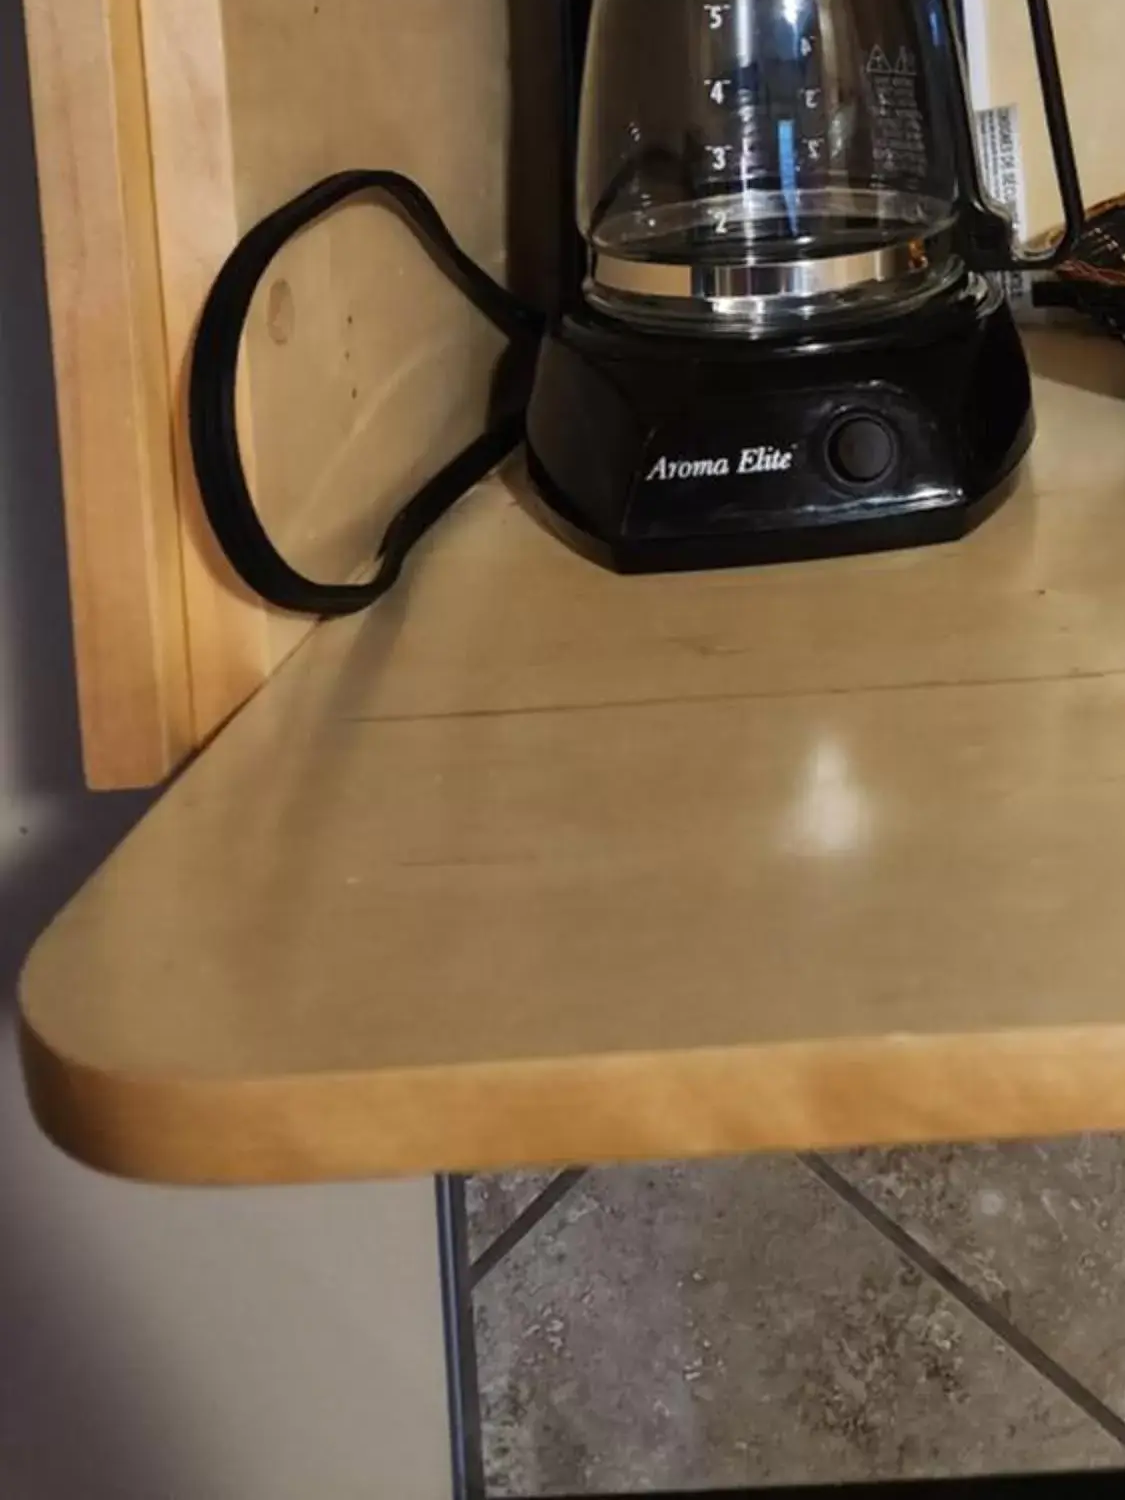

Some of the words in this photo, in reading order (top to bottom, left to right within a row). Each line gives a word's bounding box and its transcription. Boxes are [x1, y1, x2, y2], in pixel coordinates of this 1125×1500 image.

[708, 5, 723, 30] 5
[709, 80, 724, 105] 4
[711, 146, 726, 171] 3
[712, 208, 728, 234] 2
[646, 456, 729, 481] Aroma
[735, 446, 792, 474] Elite
